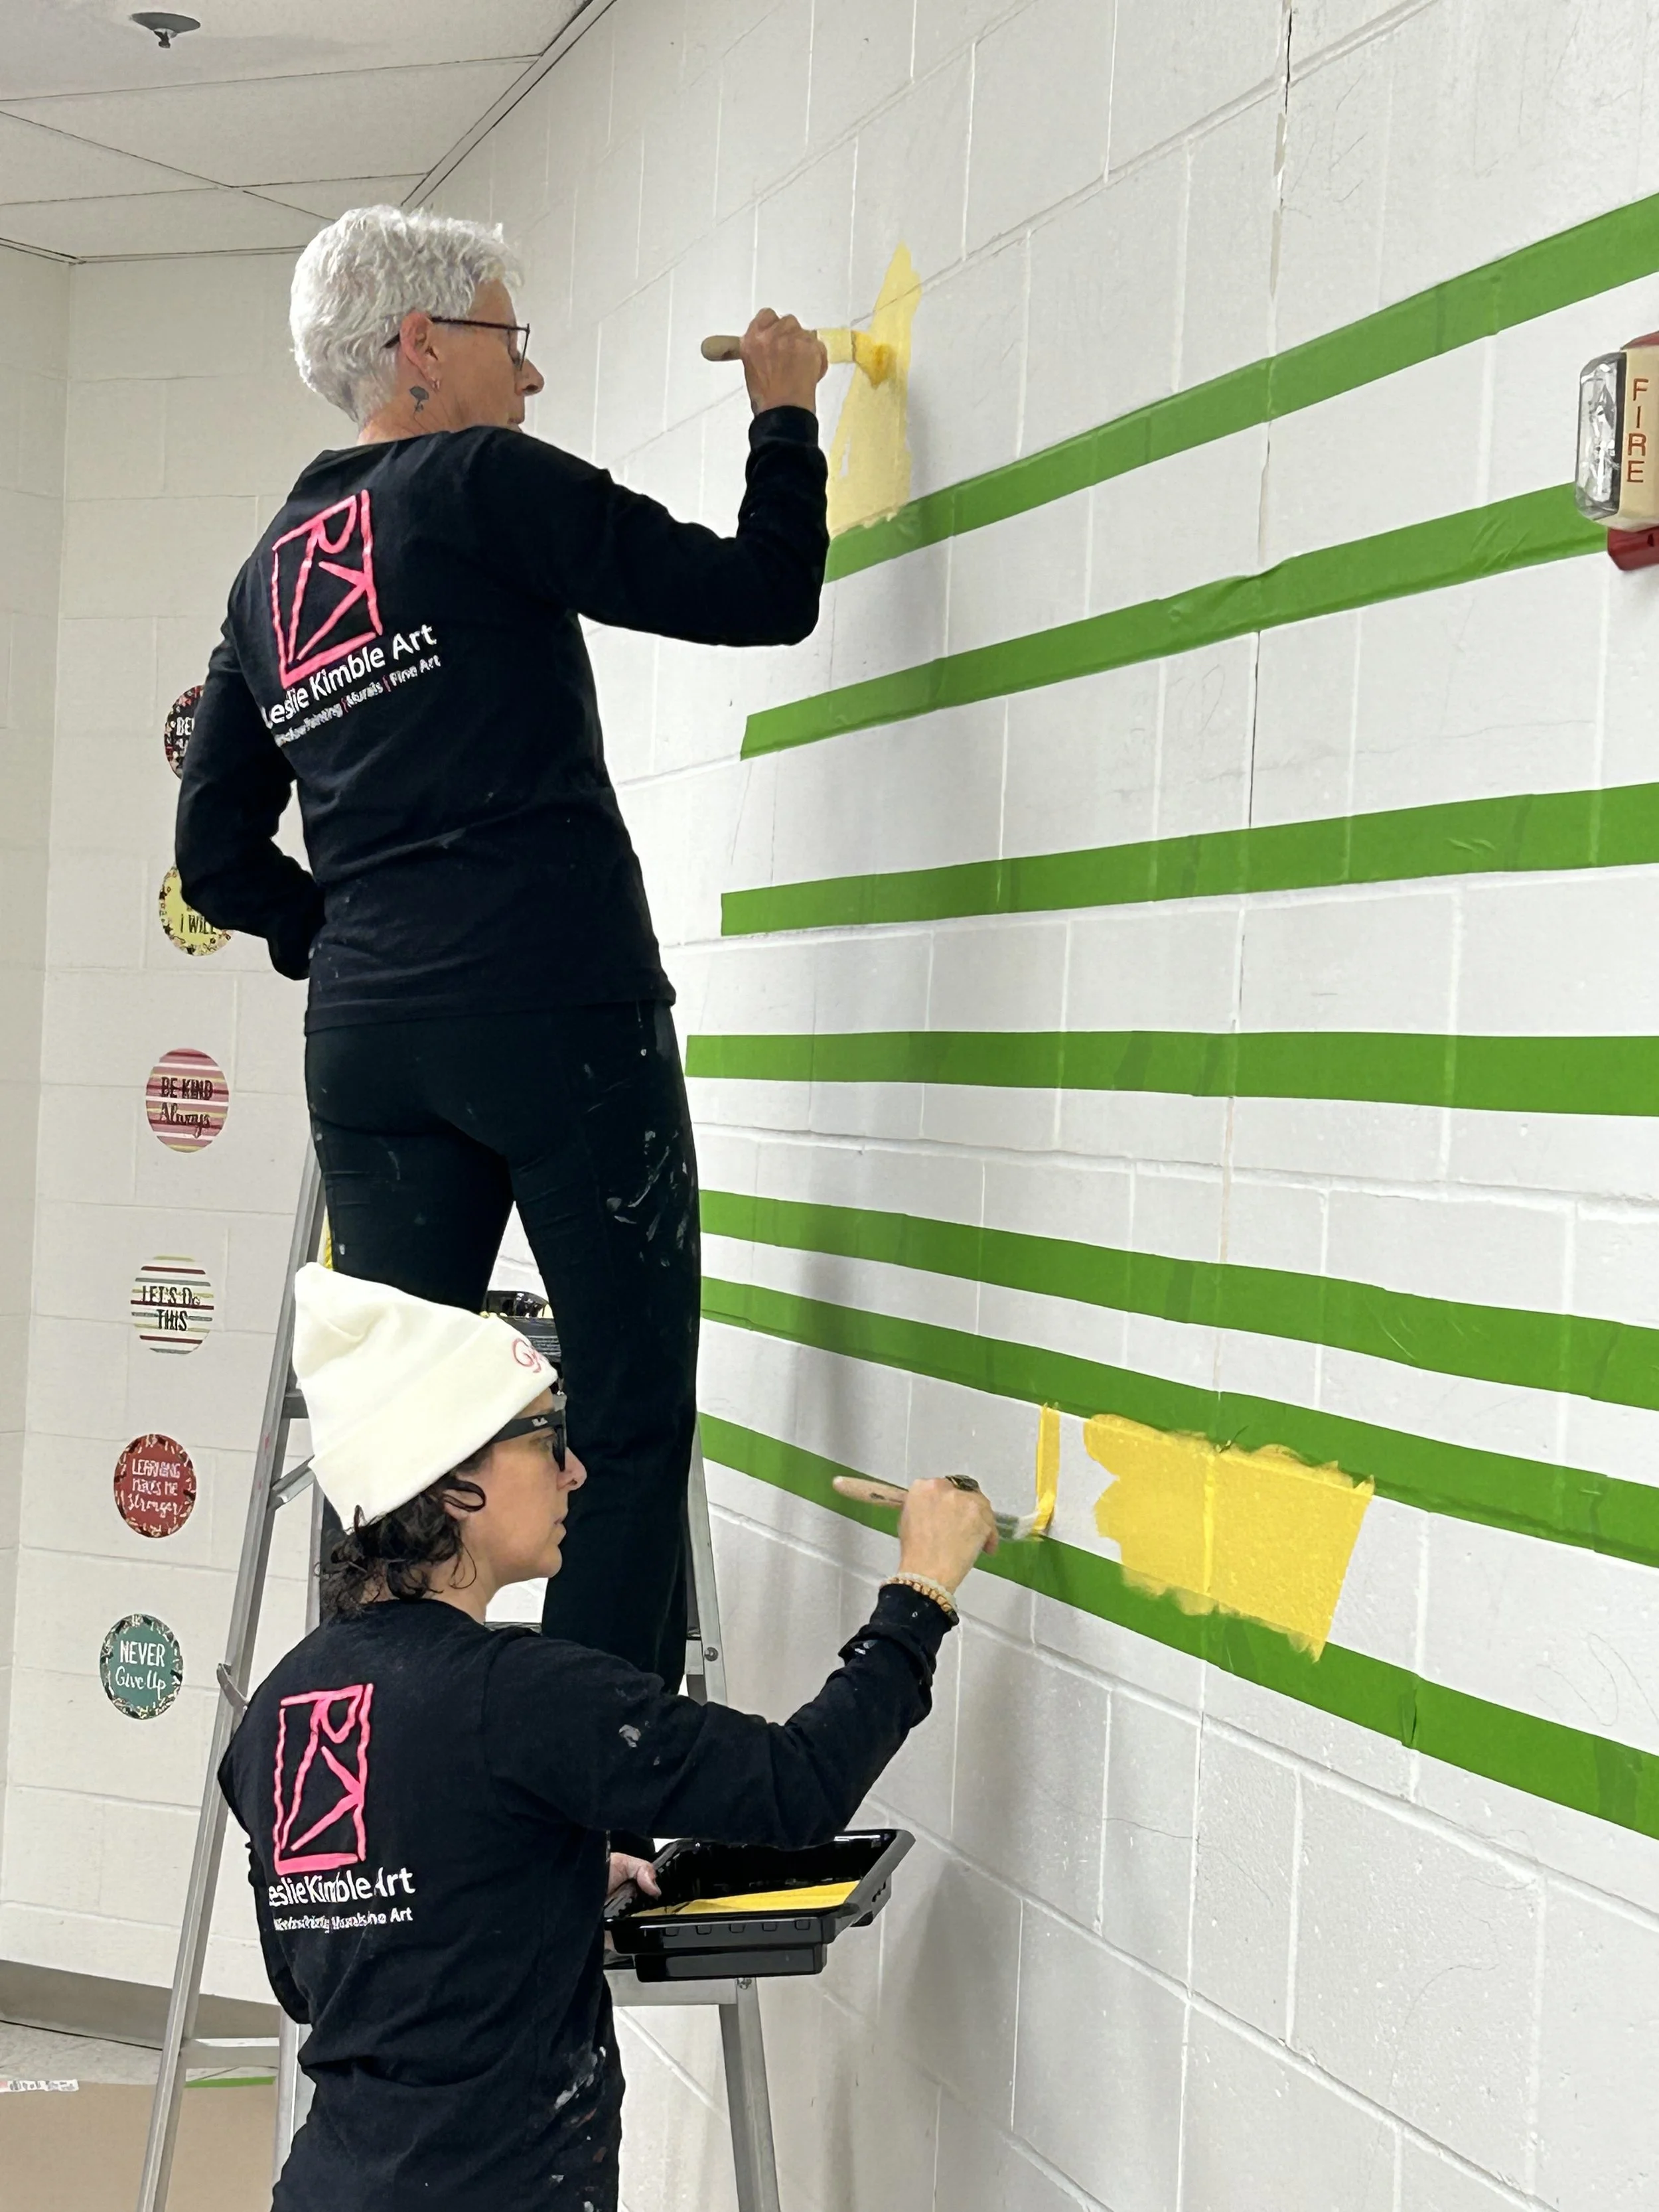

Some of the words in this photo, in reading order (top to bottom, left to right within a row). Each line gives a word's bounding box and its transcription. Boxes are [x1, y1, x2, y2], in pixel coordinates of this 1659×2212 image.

[1627, 378, 1649, 483] FIRE
[309, 646, 386, 701] Kimble
[393, 624, 437, 660] Art
[389, 666, 418, 686] Fine
[419, 654, 441, 673] Art
[161, 1076, 178, 1098] BE
[182, 1078, 214, 1100] KIND
[160, 1101, 211, 1139] Always
[157, 1309, 188, 1331] THIS
[119, 1639, 166, 1667] NEVER
[115, 1665, 145, 1690] Give
[146, 1669, 167, 1700] Up
[268, 1877, 309, 1907] eslie
[390, 1907, 413, 1923] Art
